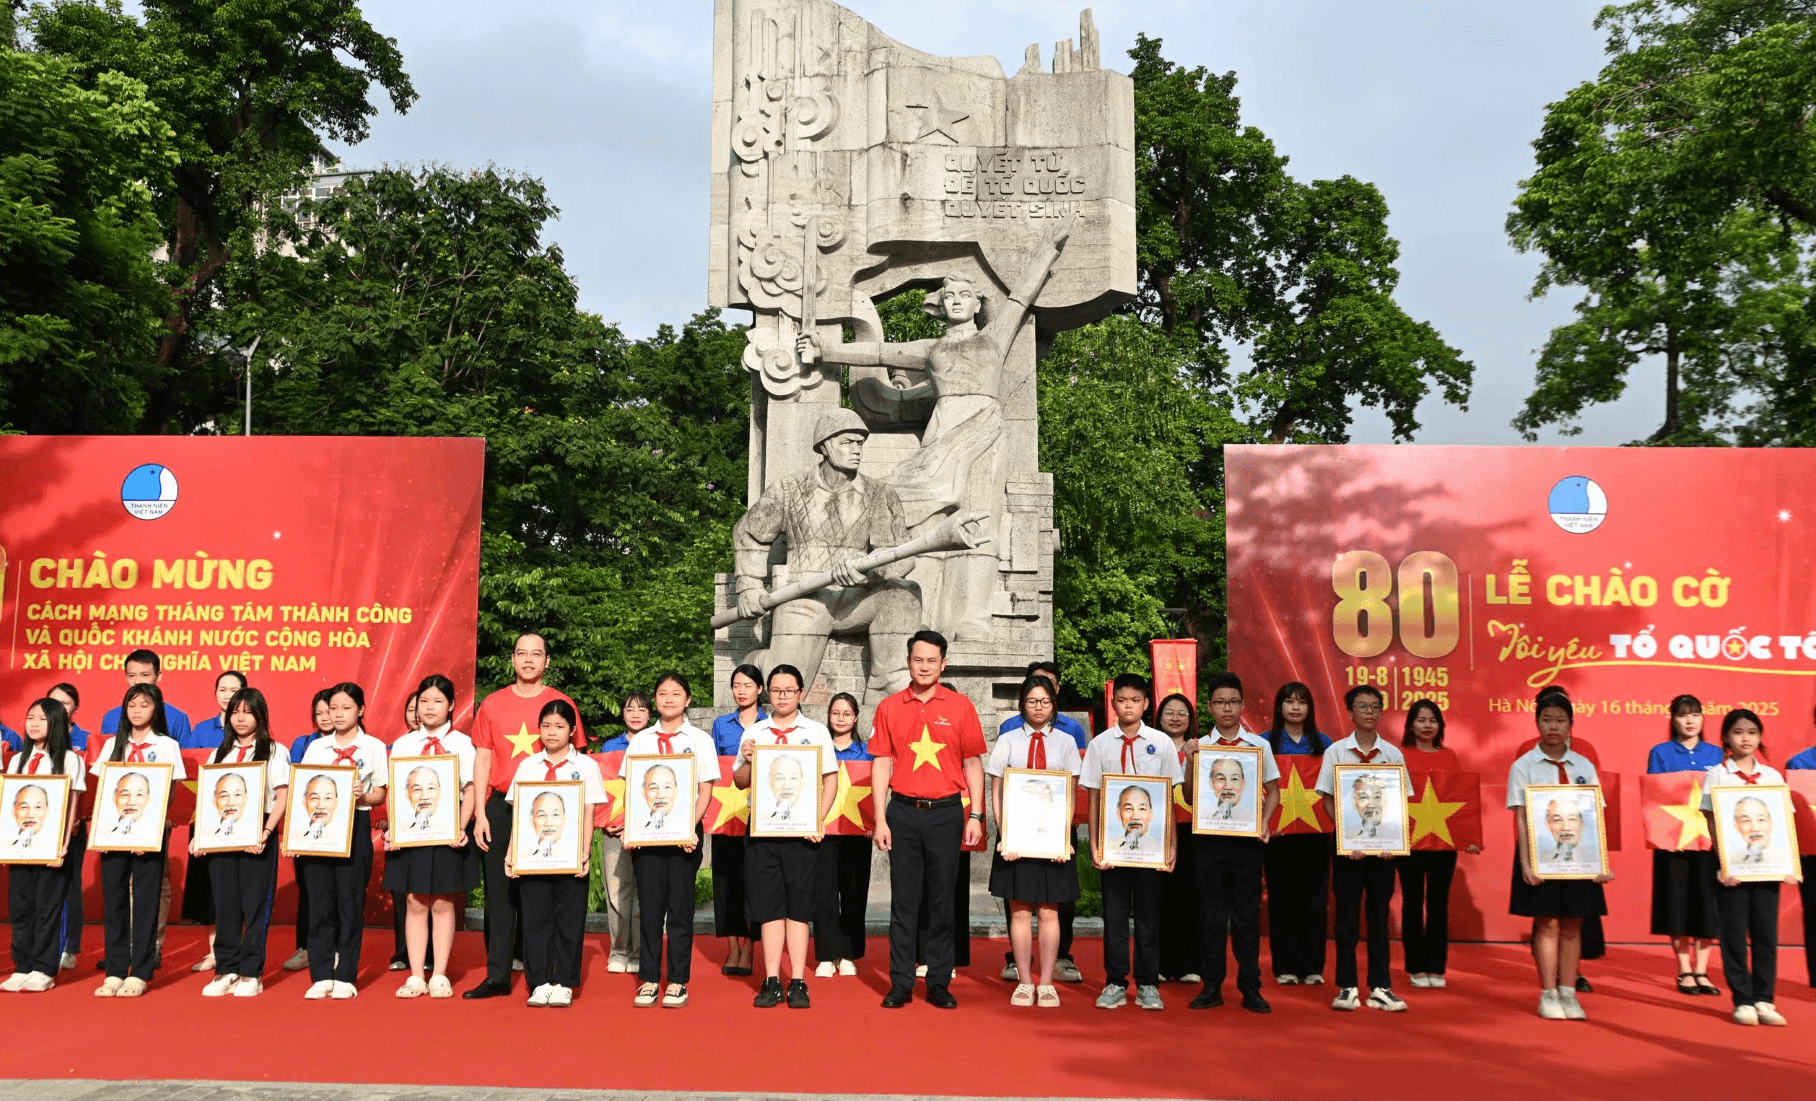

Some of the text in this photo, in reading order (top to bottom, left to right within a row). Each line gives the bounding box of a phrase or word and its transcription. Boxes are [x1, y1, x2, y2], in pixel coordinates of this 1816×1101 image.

[945, 151, 1021, 173] QUYẾT
[1023, 171, 1086, 195] QUỐC
[1029, 200, 1086, 218] SINH
[29, 549, 139, 590] CHÀO
[152, 550, 274, 590] MỪNG
[1486, 558, 1731, 608] LỄ CHÀO CỜ
[27, 600, 413, 625] CÁCH MẠNG THÁNG TÁM THÀNH CÔNG
[1332, 550, 1460, 659] 80
[25, 622, 371, 652] VÀ QUỐC KHÁNH NƯỚC CỘNG HÒA
[22, 649, 51, 671] XÃ
[58, 650, 93, 675] HỘI
[99, 650, 130, 671] CH
[218, 651, 264, 675] VIỆT
[270, 655, 316, 672] NAM
[1527, 637, 1603, 688] yêu
[1609, 624, 1658, 659] TỔ
[1668, 626, 1773, 661] QUỐC
[1345, 666, 1450, 687] 19-8 1945
[1488, 698, 1512, 713] Hà
[1515, 698, 1538, 715] Nộ
[1601, 700, 1622, 715] 16
